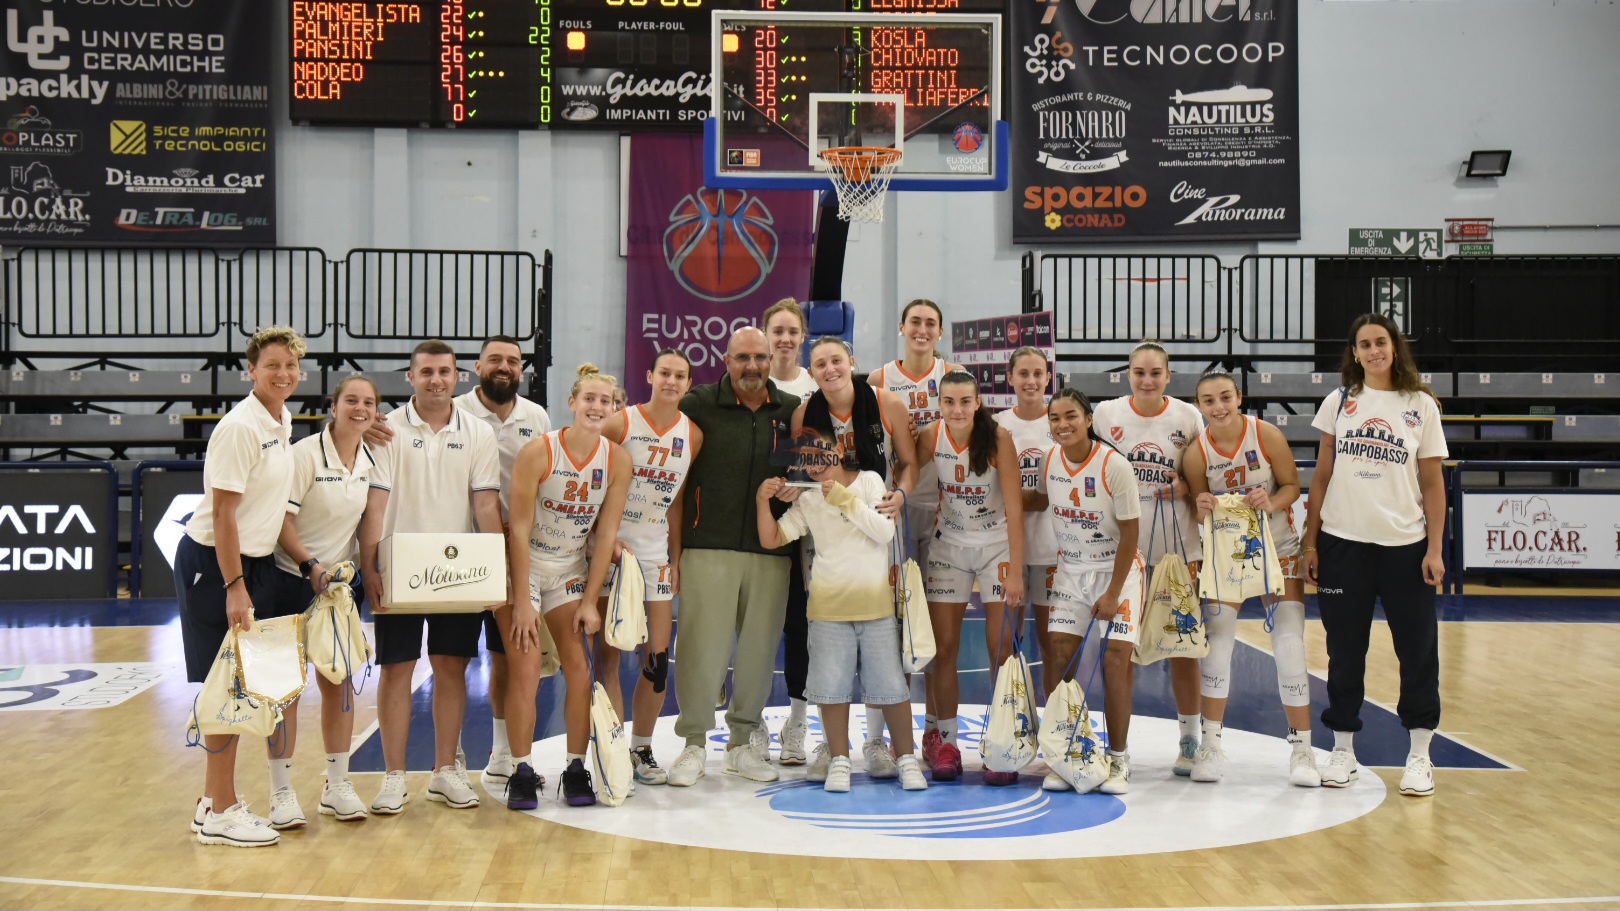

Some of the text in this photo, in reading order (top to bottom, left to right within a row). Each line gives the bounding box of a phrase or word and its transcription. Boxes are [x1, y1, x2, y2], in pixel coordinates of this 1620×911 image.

[293, 4, 550, 25] EVANGELISTA 22 0
[559, 20, 592, 29] FOULS
[1254, 11, 1276, 21] s.r.l.
[293, 21, 550, 44] PALMIERI 24 22
[618, 21, 686, 31] PLAYER-FOUL
[81, 30, 225, 51] UNIVERSO
[755, 30, 926, 48] 20 KOSLA
[293, 40, 550, 64] PANSINI 26 2
[756, 48, 959, 68] 30 CHIOVATO
[1083, 42, 1285, 66] TECNOCOOP
[83, 52, 226, 73] CERAMICHE
[293, 62, 364, 81] NADDEO
[441, 65, 463, 82] 27
[0, 73, 109, 105] packly
[115, 78, 268, 100] ALBINI & PITIGLIANI
[756, 70, 957, 88] 33 GRATTINI
[293, 81, 550, 103] COLA 77 0
[756, 90, 776, 106] 35
[1031, 92, 1132, 112] RISTORANTE & PIZZERIA
[453, 104, 550, 123] 0 0
[606, 109, 670, 120] IMPIANTI
[1168, 104, 1275, 125] NAUTILUS
[1038, 110, 1126, 139] FORNARO
[1168, 126, 1275, 136] CONSULTING S.R.L.
[1043, 141, 1071, 151] original
[946, 156, 988, 165] EUROCUP
[950, 164, 984, 172] WOMEN
[1158, 158, 1285, 167] nautilusconsultingsrl@gmail.com
[105, 167, 265, 188] Diamond Car
[1023, 185, 1147, 215] spazio
[1169, 180, 1207, 203] Cine
[1063, 212, 1126, 227] CONAD
[1174, 194, 1286, 226] Panorama
[1359, 230, 1384, 238] USCITA
[1367, 238, 1375, 247] DI
[1350, 247, 1392, 255] EMERGENZA
[890, 384, 917, 392] GIVOVA
[909, 391, 929, 409] 18
[647, 445, 670, 467] 77
[1337, 440, 1409, 465] CAMPOBASSO
[955, 464, 965, 483] 0
[1224, 465, 1246, 488] 27
[563, 480, 589, 502] 24
[1069, 487, 1080, 507] 4
[533, 523, 566, 538] AFORA
[1487, 530, 1587, 554] FLO.CAR.
[408, 564, 492, 590] Molisana
[1116, 598, 1131, 622] 4
